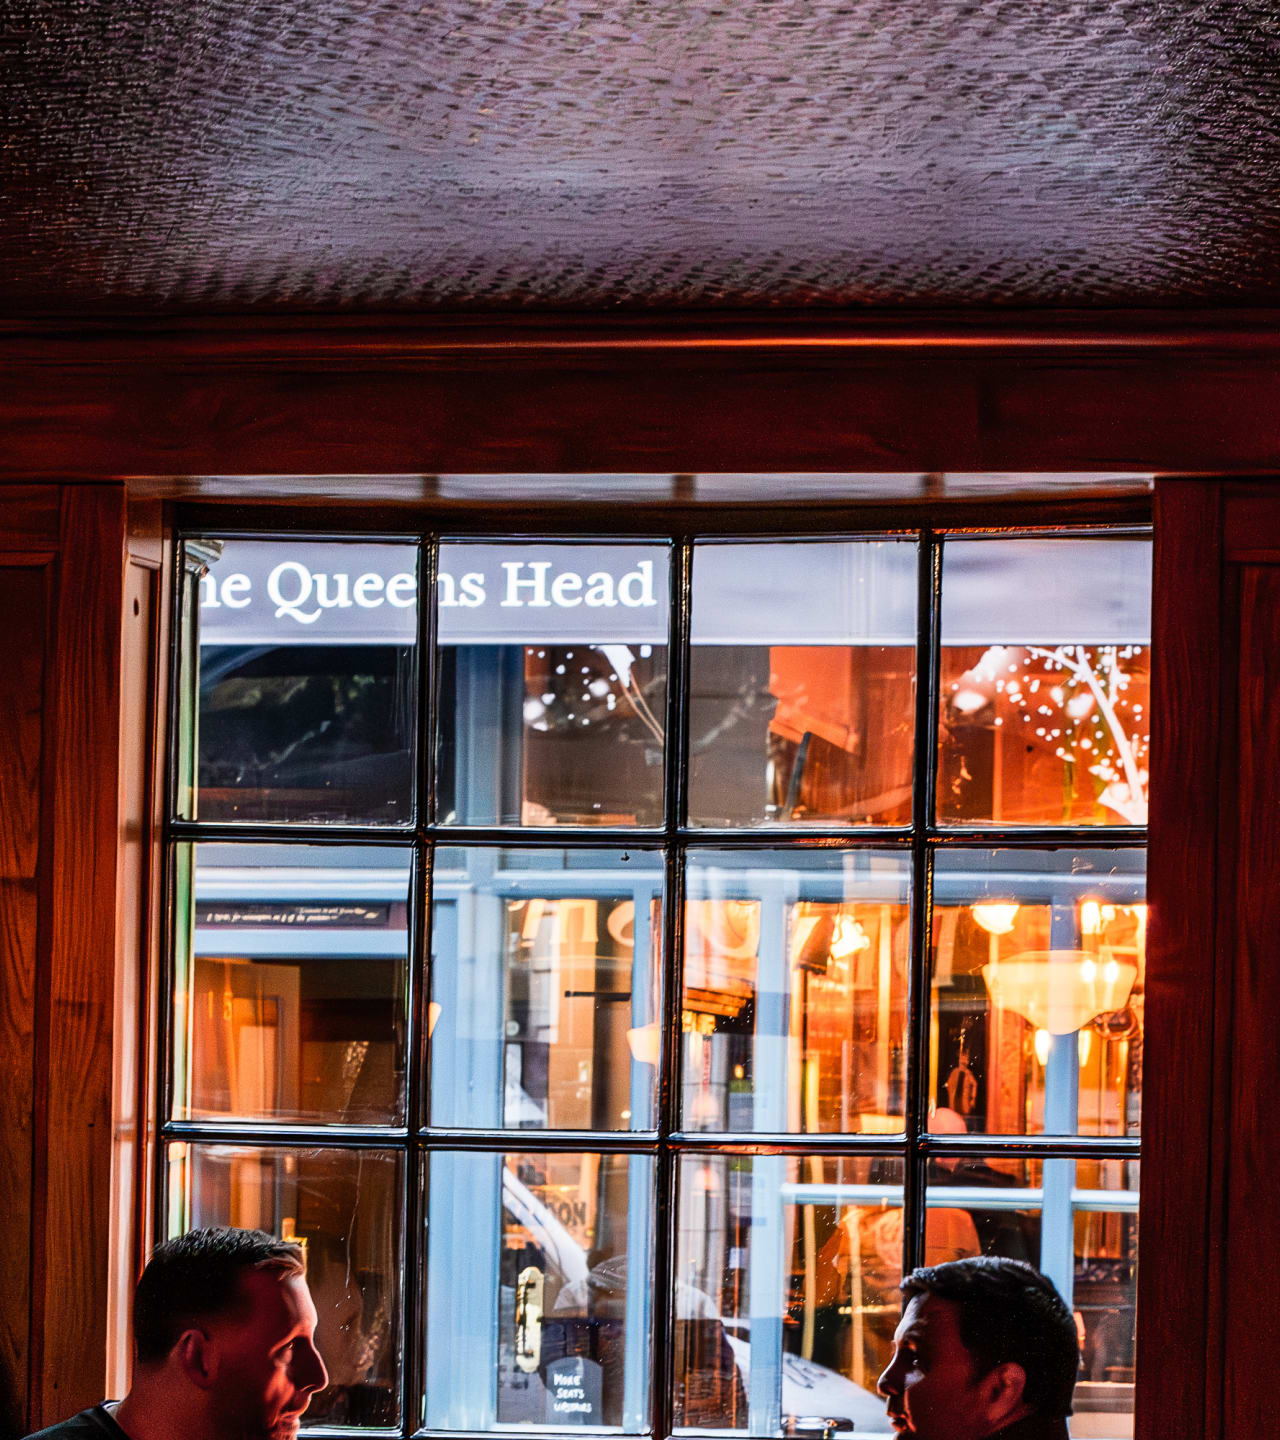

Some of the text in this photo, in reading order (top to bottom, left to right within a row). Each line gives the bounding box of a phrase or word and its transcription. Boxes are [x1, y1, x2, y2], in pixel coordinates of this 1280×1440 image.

[267, 561, 486, 624] Queens
[500, 560, 658, 608] Head
[556, 1387, 585, 1400] SEATS
